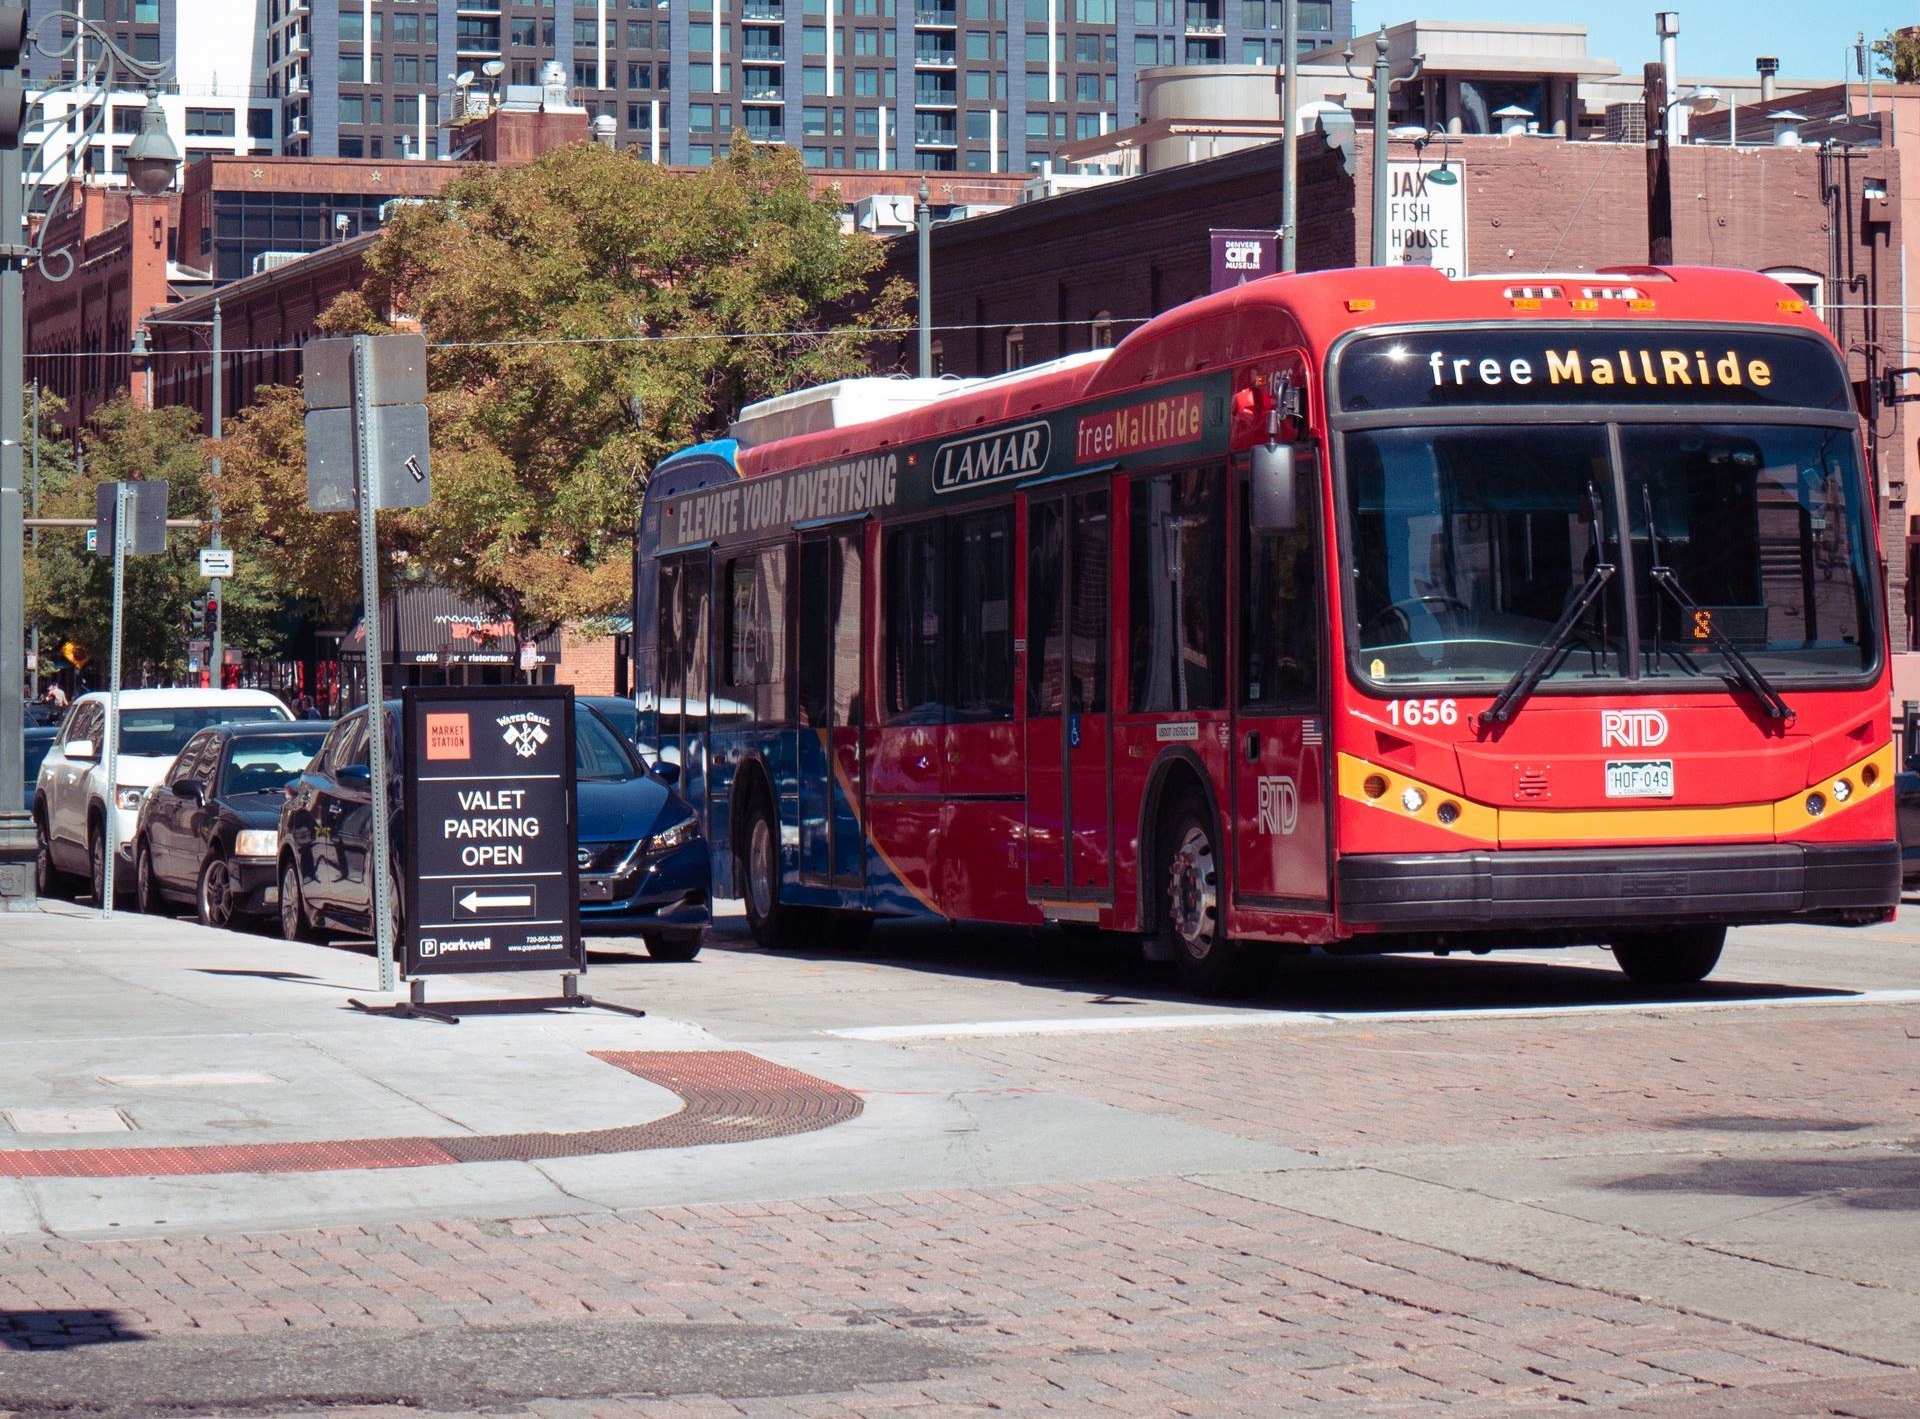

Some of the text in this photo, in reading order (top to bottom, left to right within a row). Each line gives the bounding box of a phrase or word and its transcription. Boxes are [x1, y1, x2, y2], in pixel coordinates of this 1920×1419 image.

[1391, 171, 1428, 197] JAX
[1391, 203, 1430, 222] FISH
[1391, 228, 1450, 248] HOUSE
[1225, 244, 1262, 263] art
[1393, 254, 1412, 262] AND
[1225, 262, 1260, 270] MUSEUM
[1429, 350, 1772, 387] free MallRide
[942, 430, 1040, 486] LAMAR
[678, 453, 898, 544] ELEVATE YOUR ADVERTISING
[416, 653, 438, 662] caffé
[468, 653, 508, 662] ristorante
[496, 712, 551, 727] WATER GRILL
[1386, 698, 1458, 726] 1656
[431, 725, 464, 736] MARKET
[1601, 709, 1669, 748] RTD
[431, 736, 465, 748] STATION
[457, 790, 526, 811] VALET
[1257, 775, 1298, 835] RTD
[444, 817, 540, 839] PARKING
[461, 845, 523, 866] OPEN
[439, 937, 492, 954] parkwell
